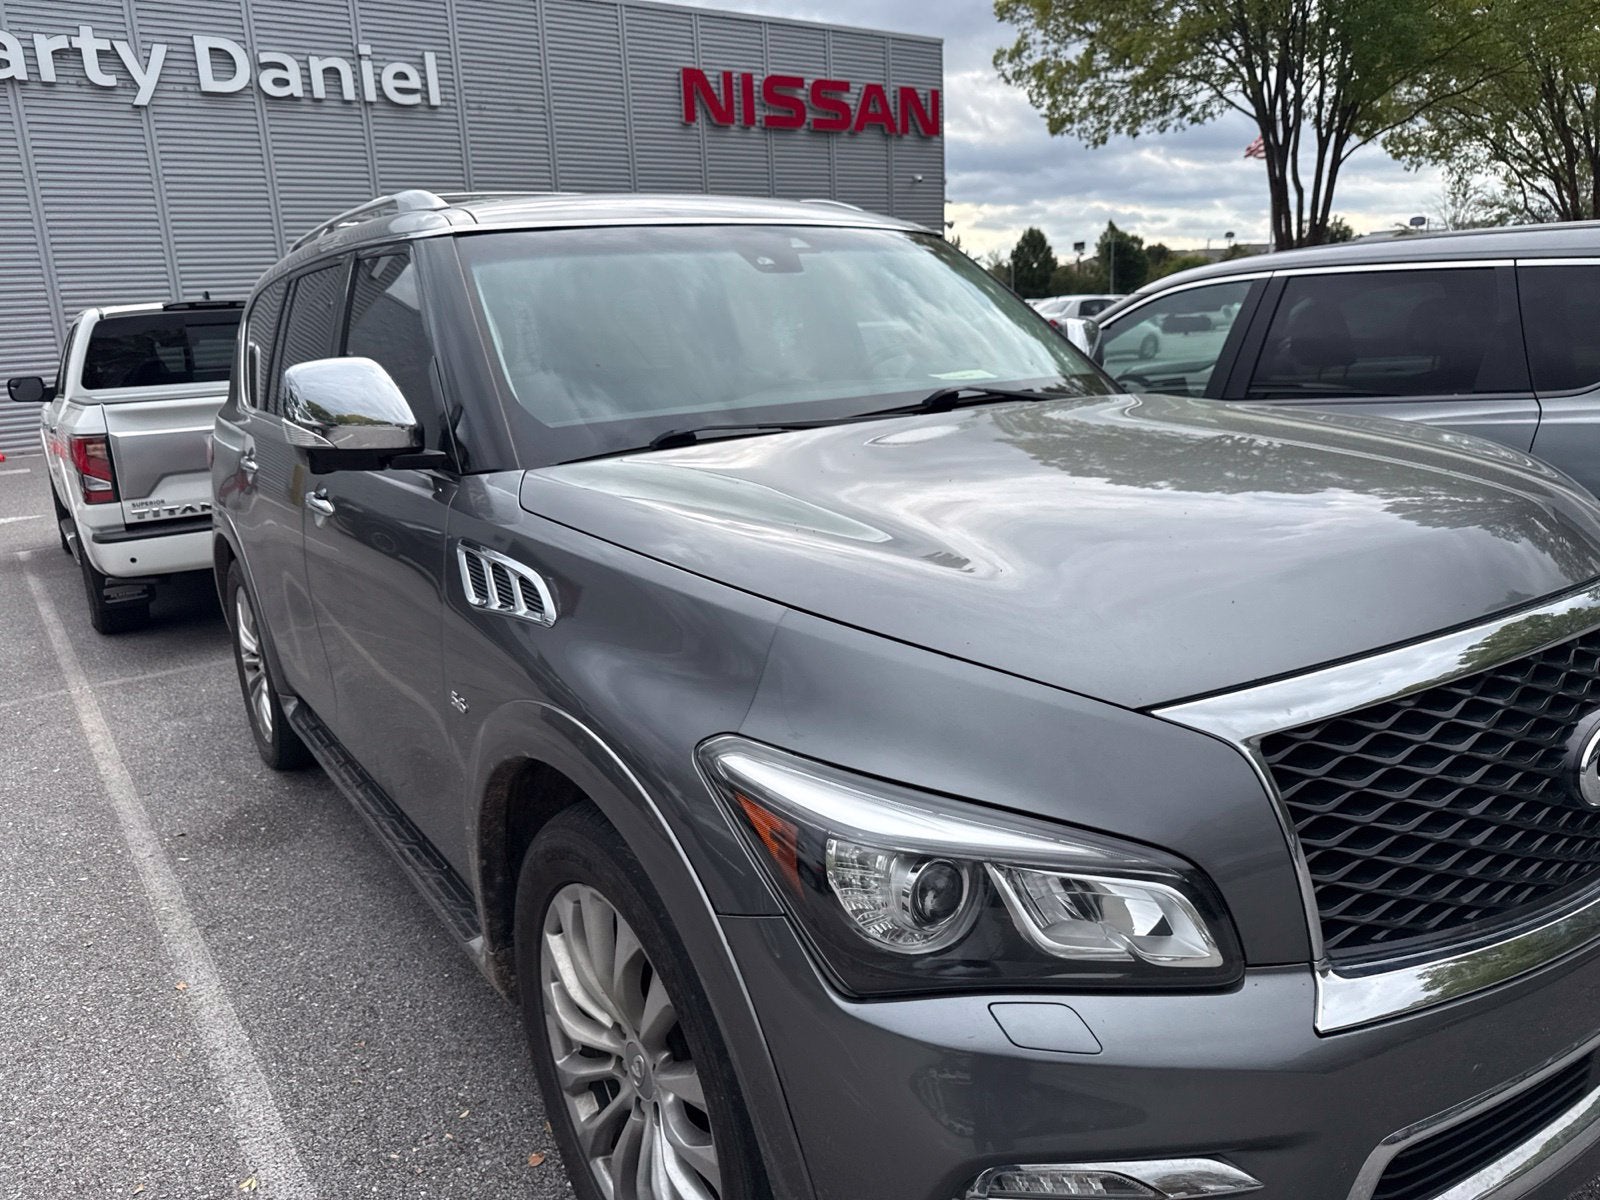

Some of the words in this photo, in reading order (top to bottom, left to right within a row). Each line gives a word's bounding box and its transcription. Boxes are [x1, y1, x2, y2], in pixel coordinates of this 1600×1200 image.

[193, 34, 441, 107] Daniel
[680, 67, 940, 136] NISSAN
[131, 499, 166, 508] SUPERIOR
